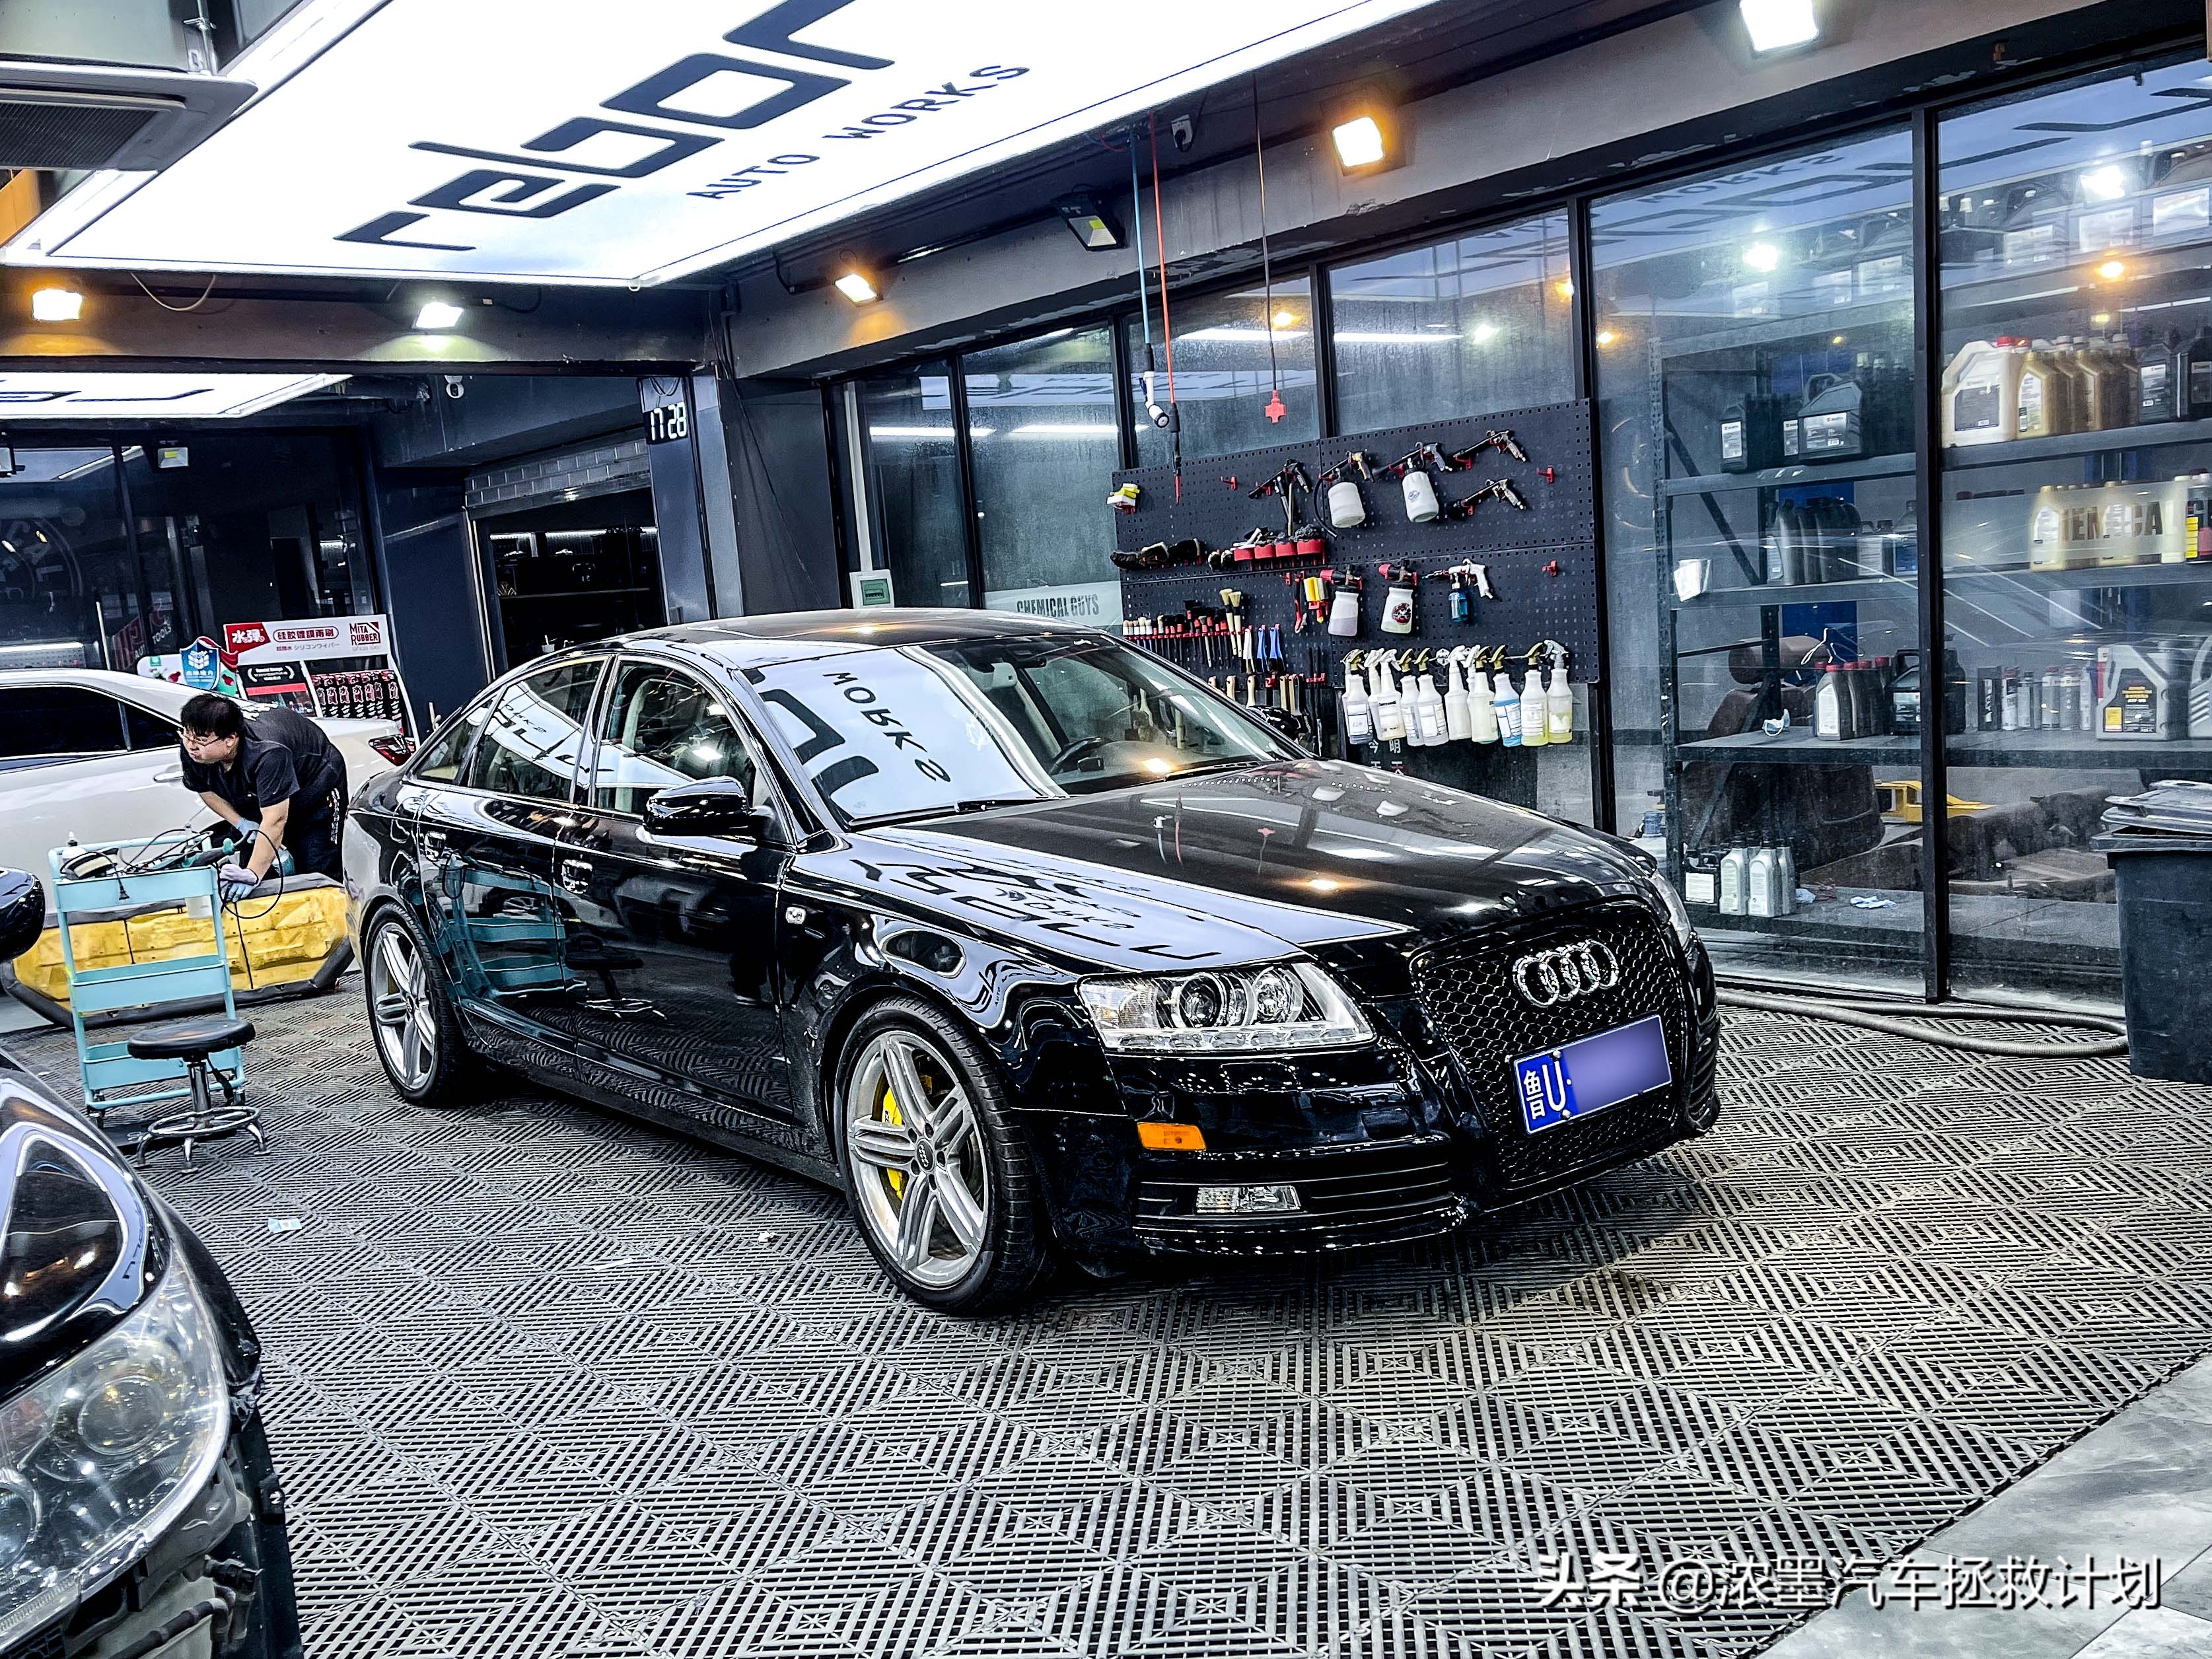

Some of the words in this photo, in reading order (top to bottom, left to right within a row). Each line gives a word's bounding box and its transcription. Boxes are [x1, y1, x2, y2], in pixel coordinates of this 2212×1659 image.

[686, 153, 821, 201] AUTO
[822, 65, 1030, 139] WORKS
[1017, 597, 1068, 618] CHEMICAL
[1071, 594, 1100, 616] GUYS
[349, 623, 369, 634] MITA
[351, 633, 378, 646] RUBBER
